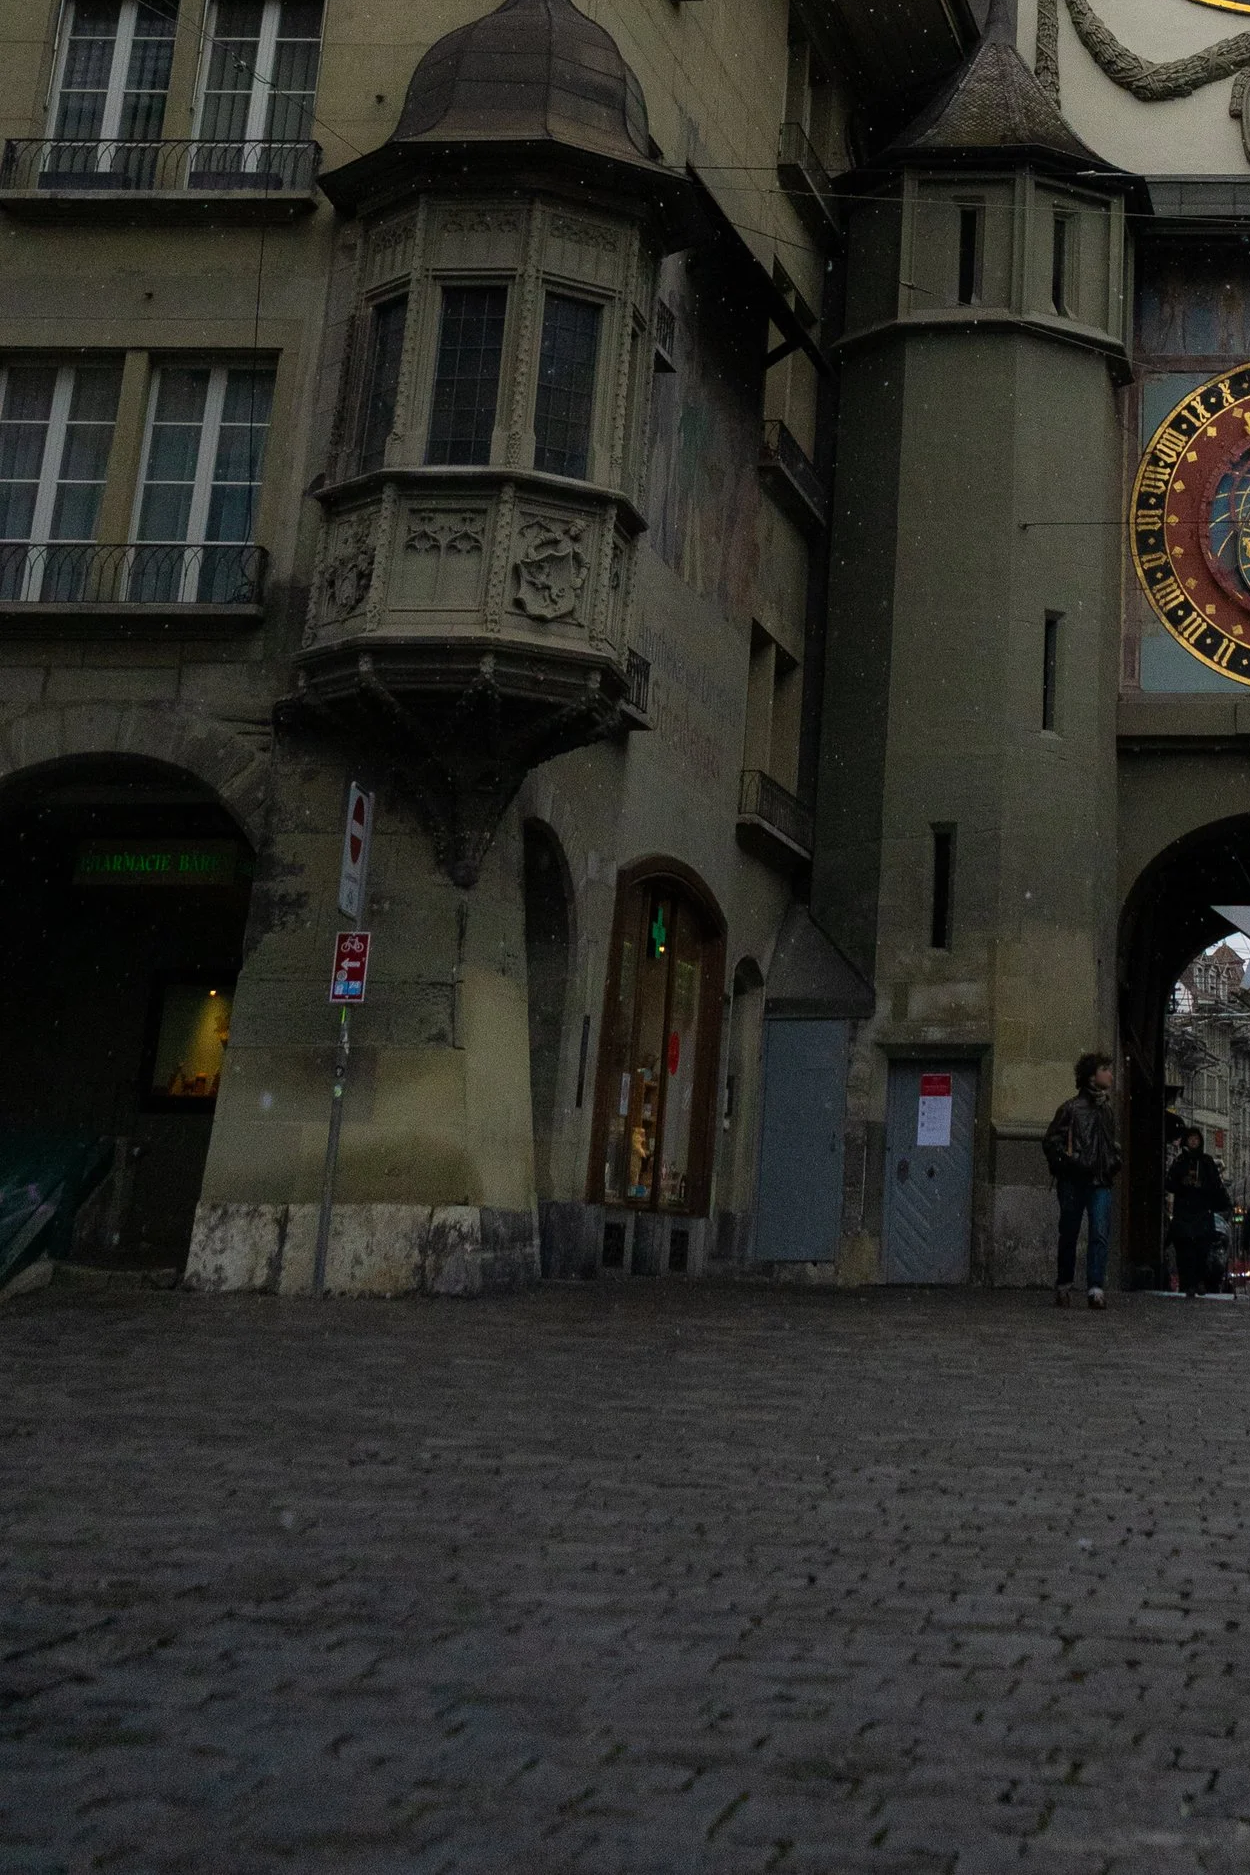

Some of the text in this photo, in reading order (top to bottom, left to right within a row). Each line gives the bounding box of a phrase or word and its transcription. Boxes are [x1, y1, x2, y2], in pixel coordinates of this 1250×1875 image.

[1218, 380, 1235, 403] X
[1190, 396, 1211, 427] IX
[1179, 611, 1207, 643] III
[1214, 643, 1236, 666] II
